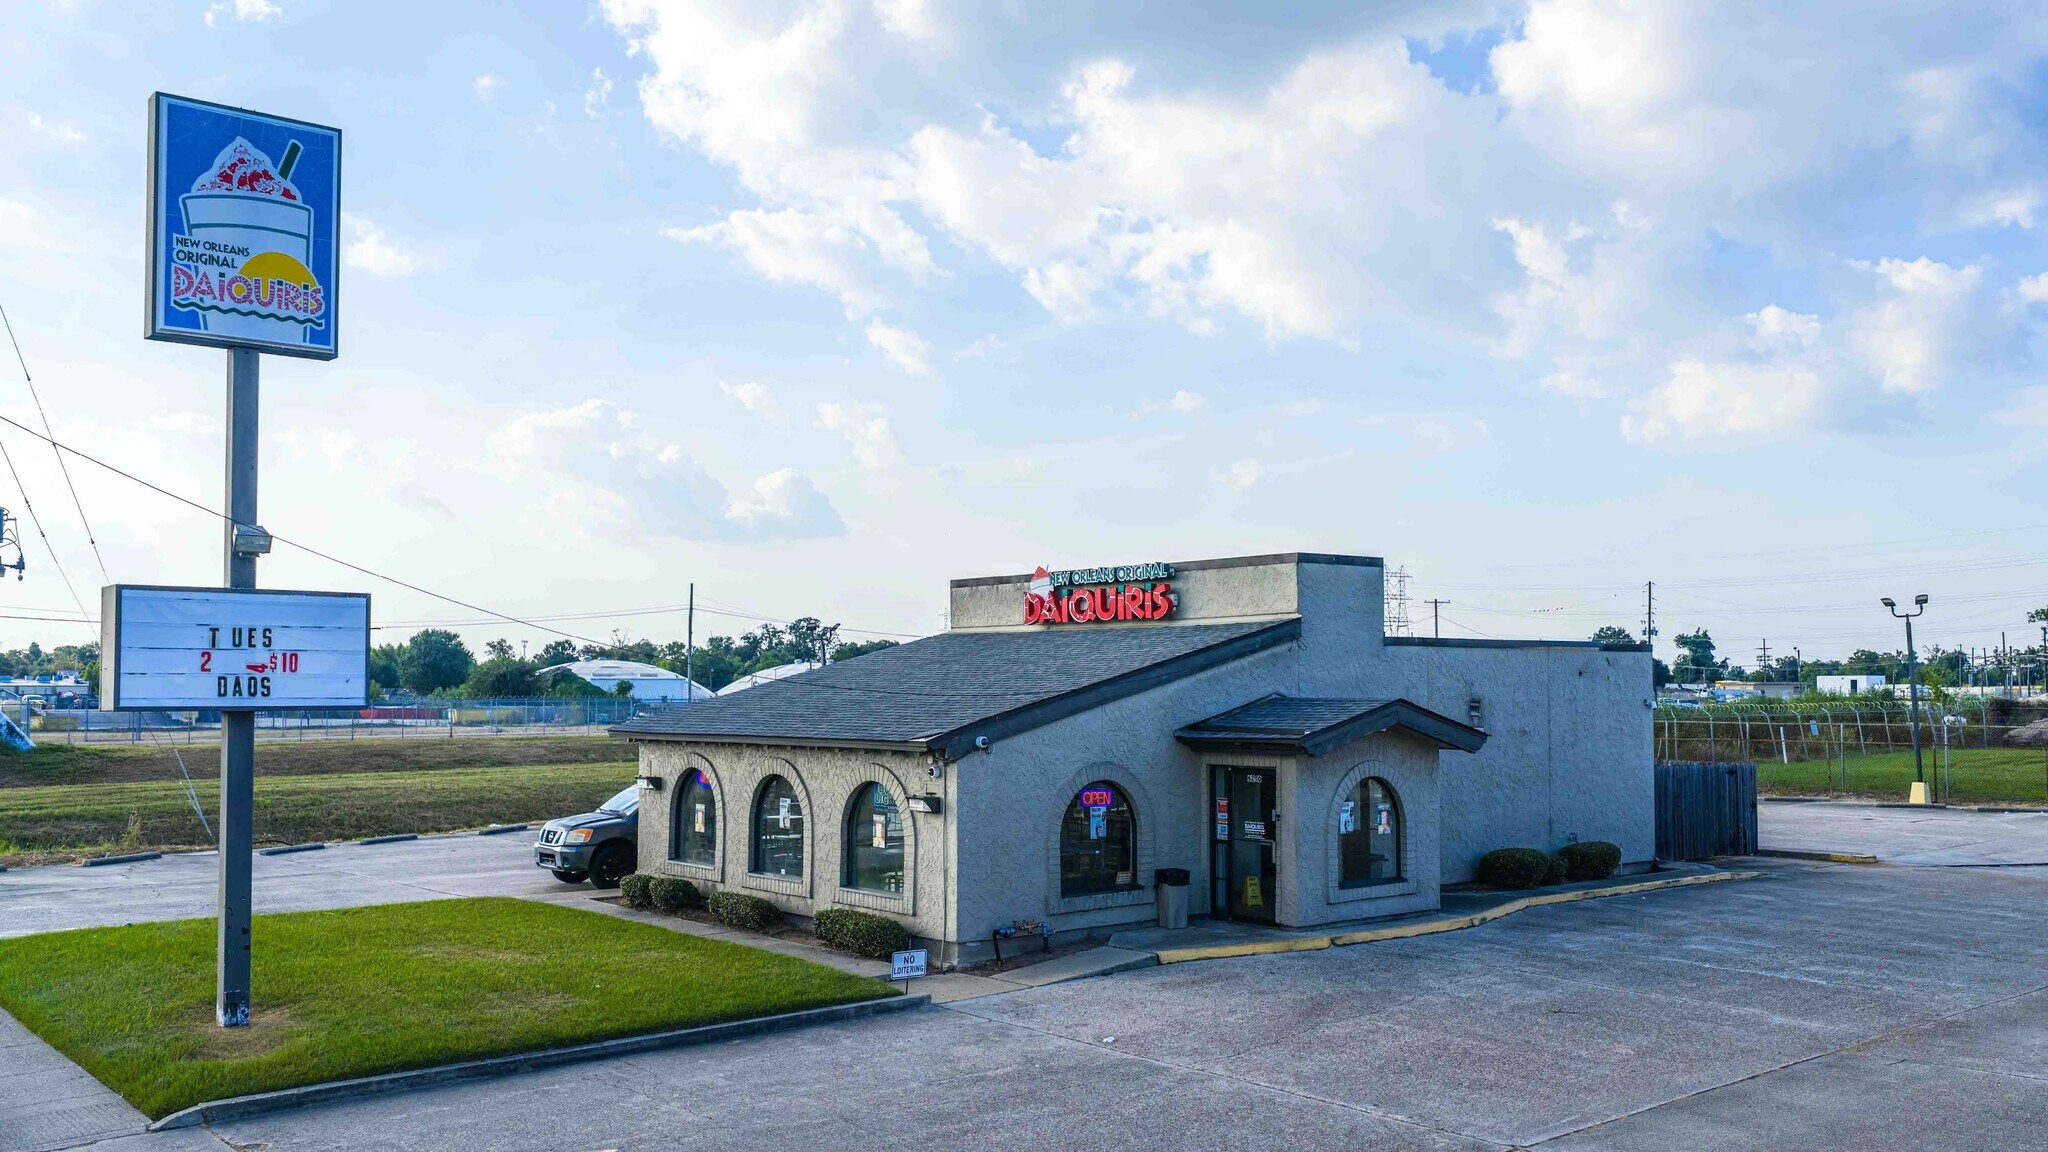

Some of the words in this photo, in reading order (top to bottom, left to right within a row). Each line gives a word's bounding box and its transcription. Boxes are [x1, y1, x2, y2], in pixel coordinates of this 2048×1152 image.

[175, 236, 201, 249] NEW
[202, 241, 250, 257] ORLEANS
[176, 250, 238, 269] ORIGINAL
[1051, 571, 1070, 586] NEW
[1072, 566, 1115, 585] ORLEANS
[1116, 563, 1169, 582] ORIGINAL
[209, 627, 272, 648] TUES
[200, 651, 212, 672] 2
[270, 652, 298, 673] $10
[876, 792, 895, 805] LIGH
[1083, 791, 1111, 805] OPEN
[903, 955, 915, 965] NO
[893, 965, 924, 975] LOITERING
